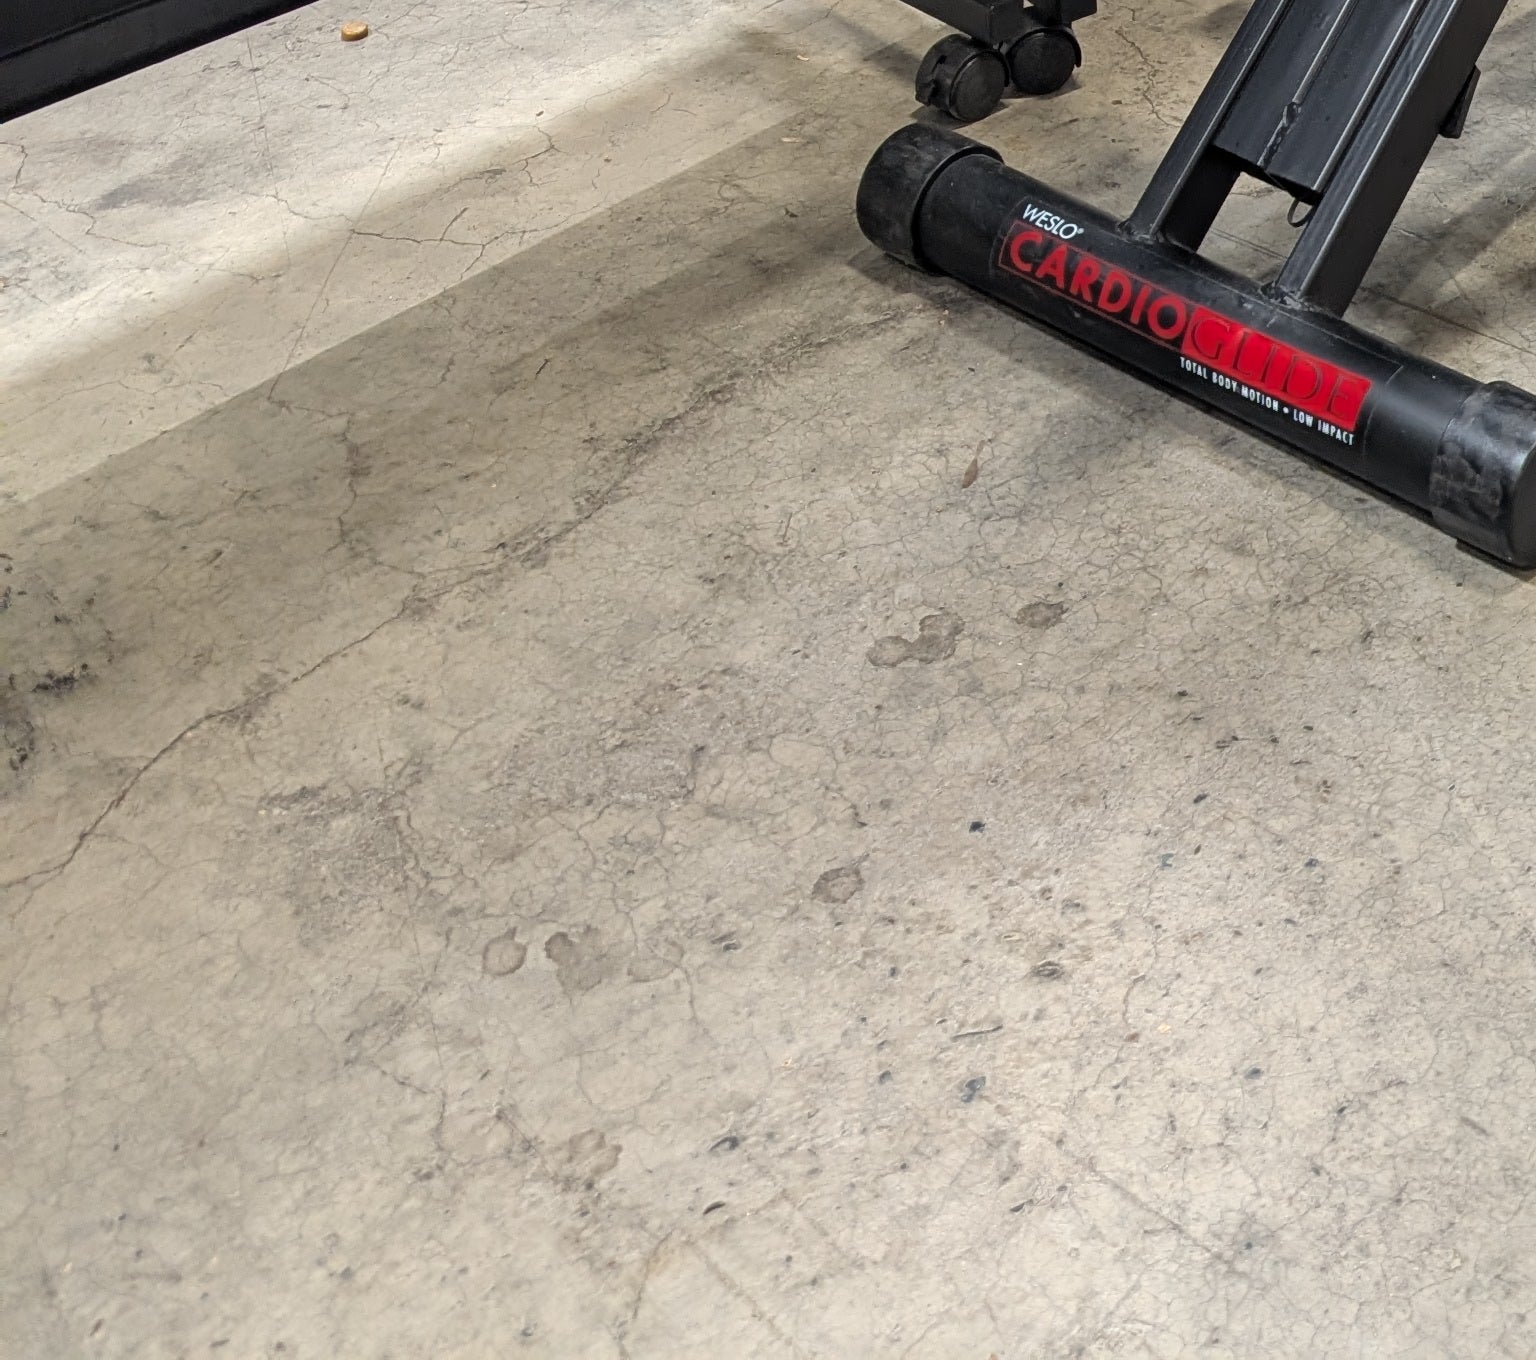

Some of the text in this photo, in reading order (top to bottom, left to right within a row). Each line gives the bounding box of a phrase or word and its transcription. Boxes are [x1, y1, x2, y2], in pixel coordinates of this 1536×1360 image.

[1179, 356, 1355, 446] TOTAL BODY MOTION LOW IMPACT
